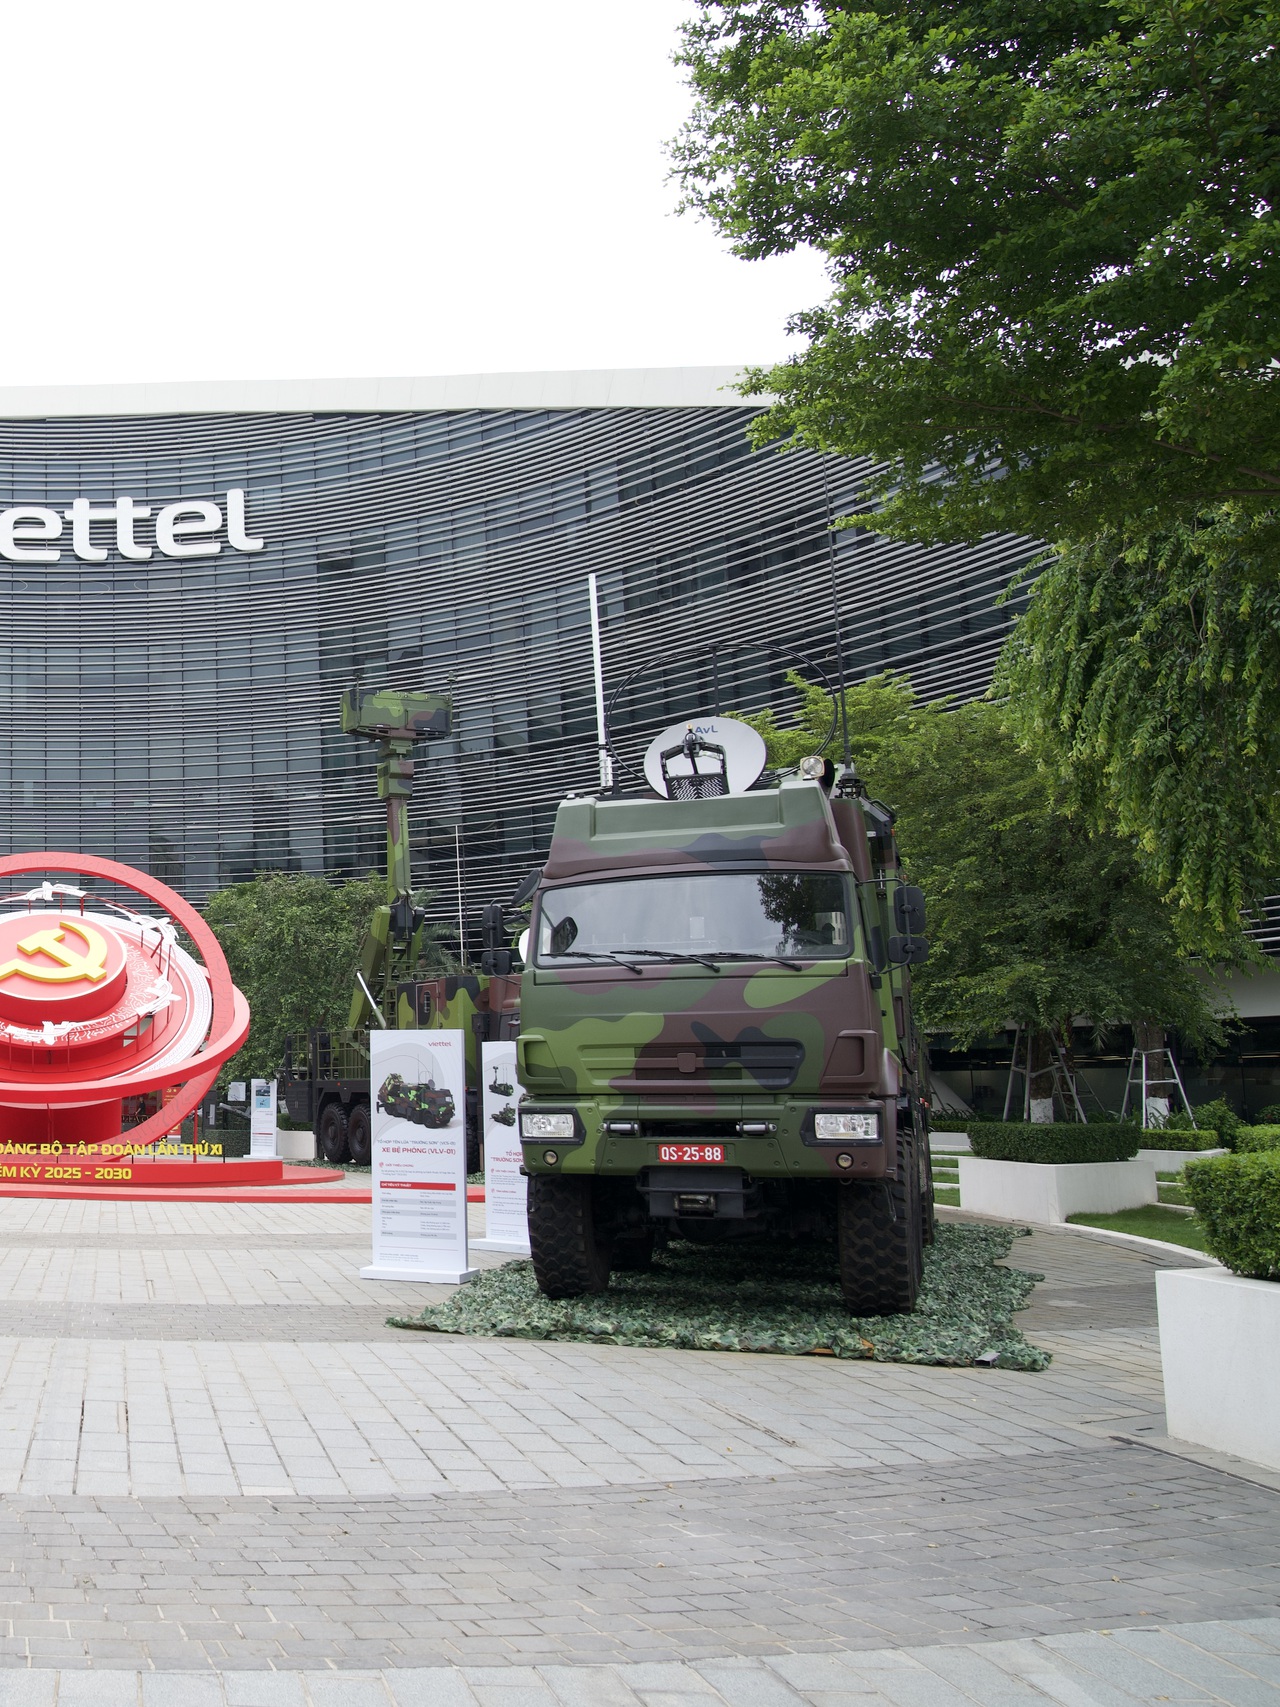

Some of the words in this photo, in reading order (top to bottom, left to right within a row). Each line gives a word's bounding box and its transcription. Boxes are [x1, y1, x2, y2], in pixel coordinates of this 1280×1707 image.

[695, 725, 718, 734] AvL
[40, 1140, 62, 1156] BỘ
[66, 1140, 98, 1157] TẬP
[100, 1140, 145, 1156] ĐOÀN
[148, 1138, 178, 1156] LẦN
[181, 1140, 208, 1156] THỨ
[210, 1144, 222, 1155] XI
[661, 1146, 721, 1160] QS-25-88
[20, 1163, 42, 1178] KỲ
[44, 1166, 82, 1179] 2025
[94, 1168, 132, 1180] 2030
